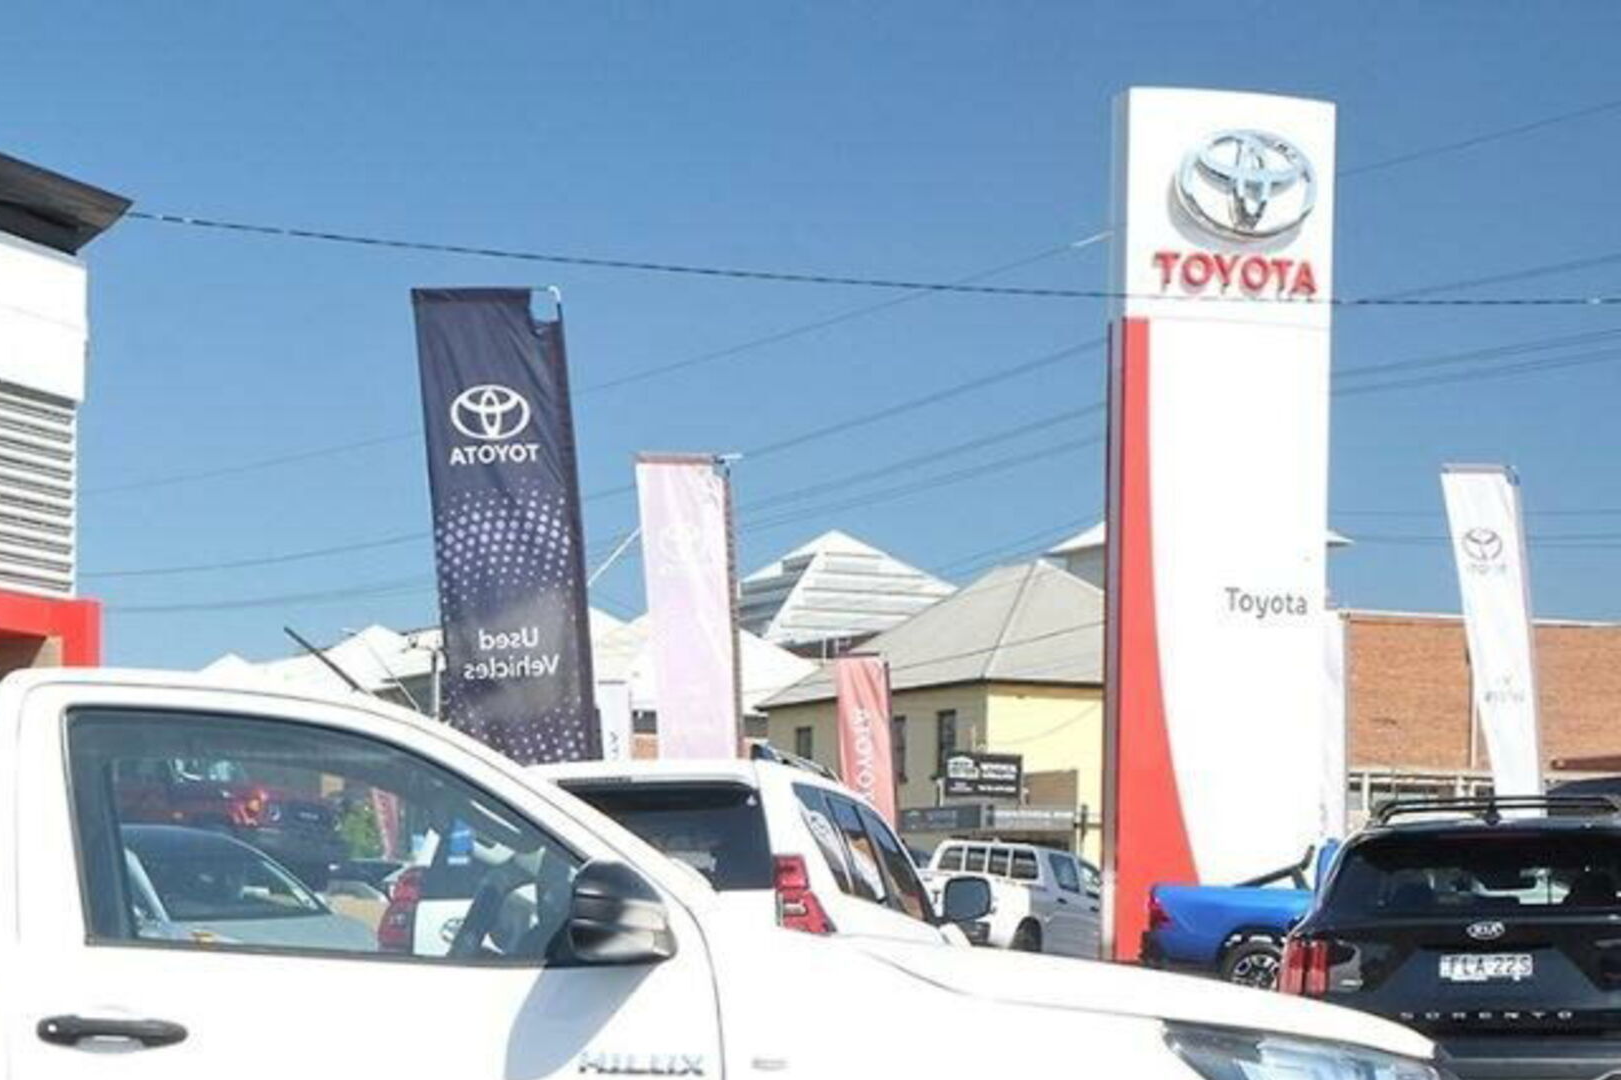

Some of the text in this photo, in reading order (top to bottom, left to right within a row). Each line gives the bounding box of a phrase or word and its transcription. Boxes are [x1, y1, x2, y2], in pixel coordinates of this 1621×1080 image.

[1153, 251, 1317, 295] TOYOTA
[1224, 586, 1308, 619] Toyota
[579, 1052, 704, 1076] HILUX
